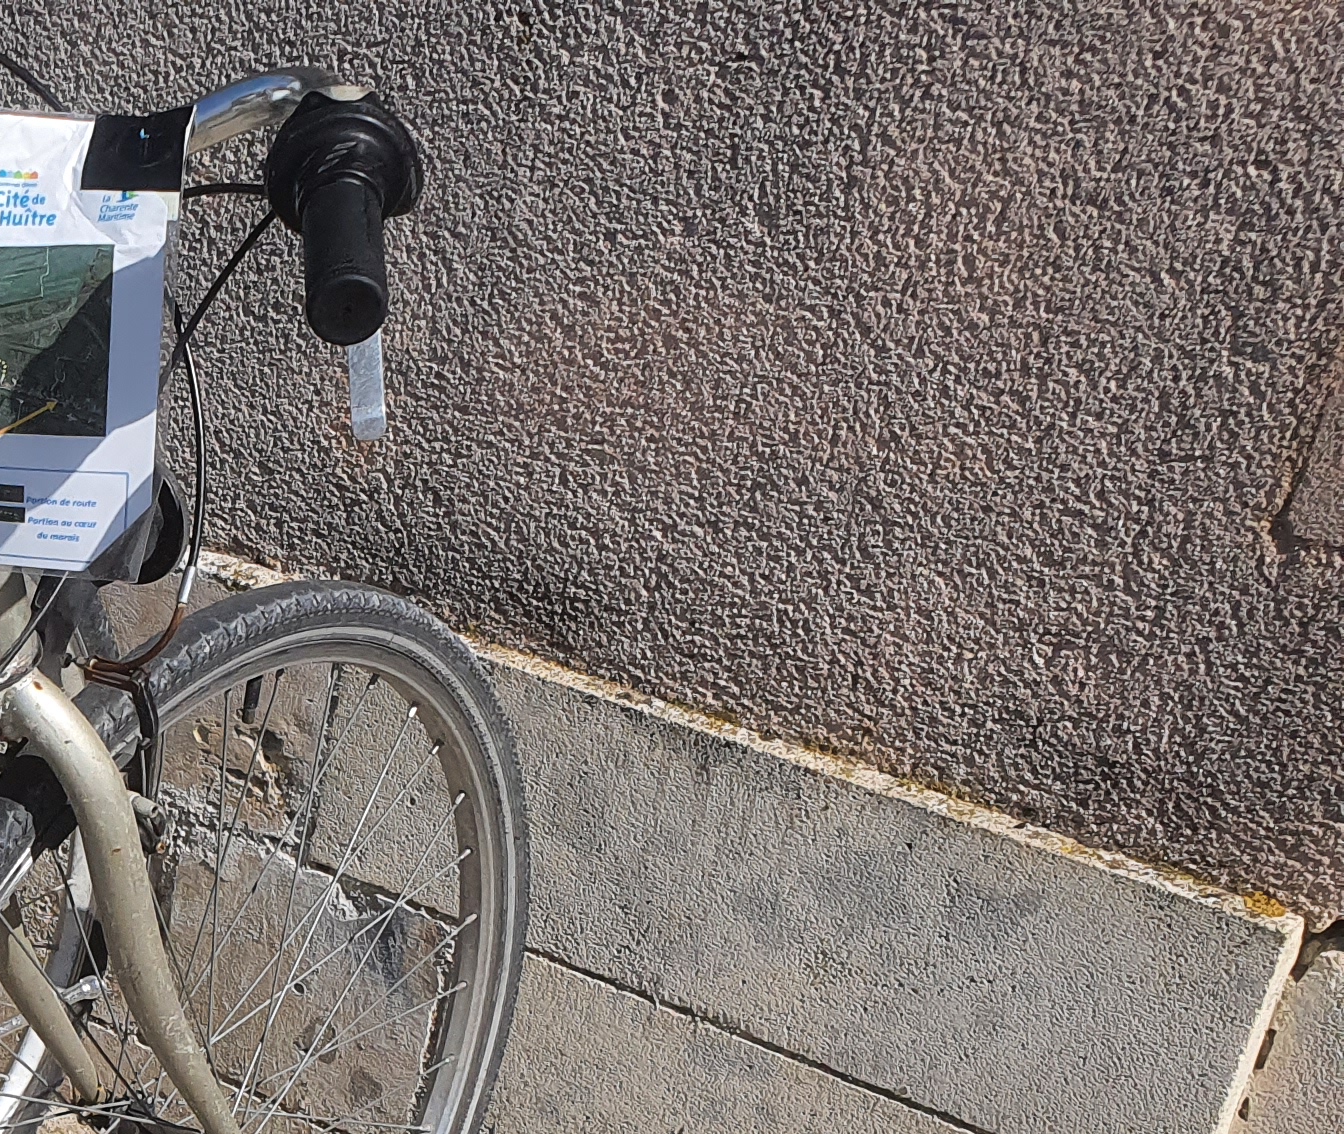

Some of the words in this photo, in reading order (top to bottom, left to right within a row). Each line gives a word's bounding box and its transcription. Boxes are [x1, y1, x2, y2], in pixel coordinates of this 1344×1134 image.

[32, 193, 46, 205] de
[26, 496, 58, 506] Portion
[60, 497, 70, 507] de
[27, 516, 59, 527] Portion
[61, 520, 72, 528] au
[36, 532, 48, 540] du
[49, 532, 81, 543] marais
